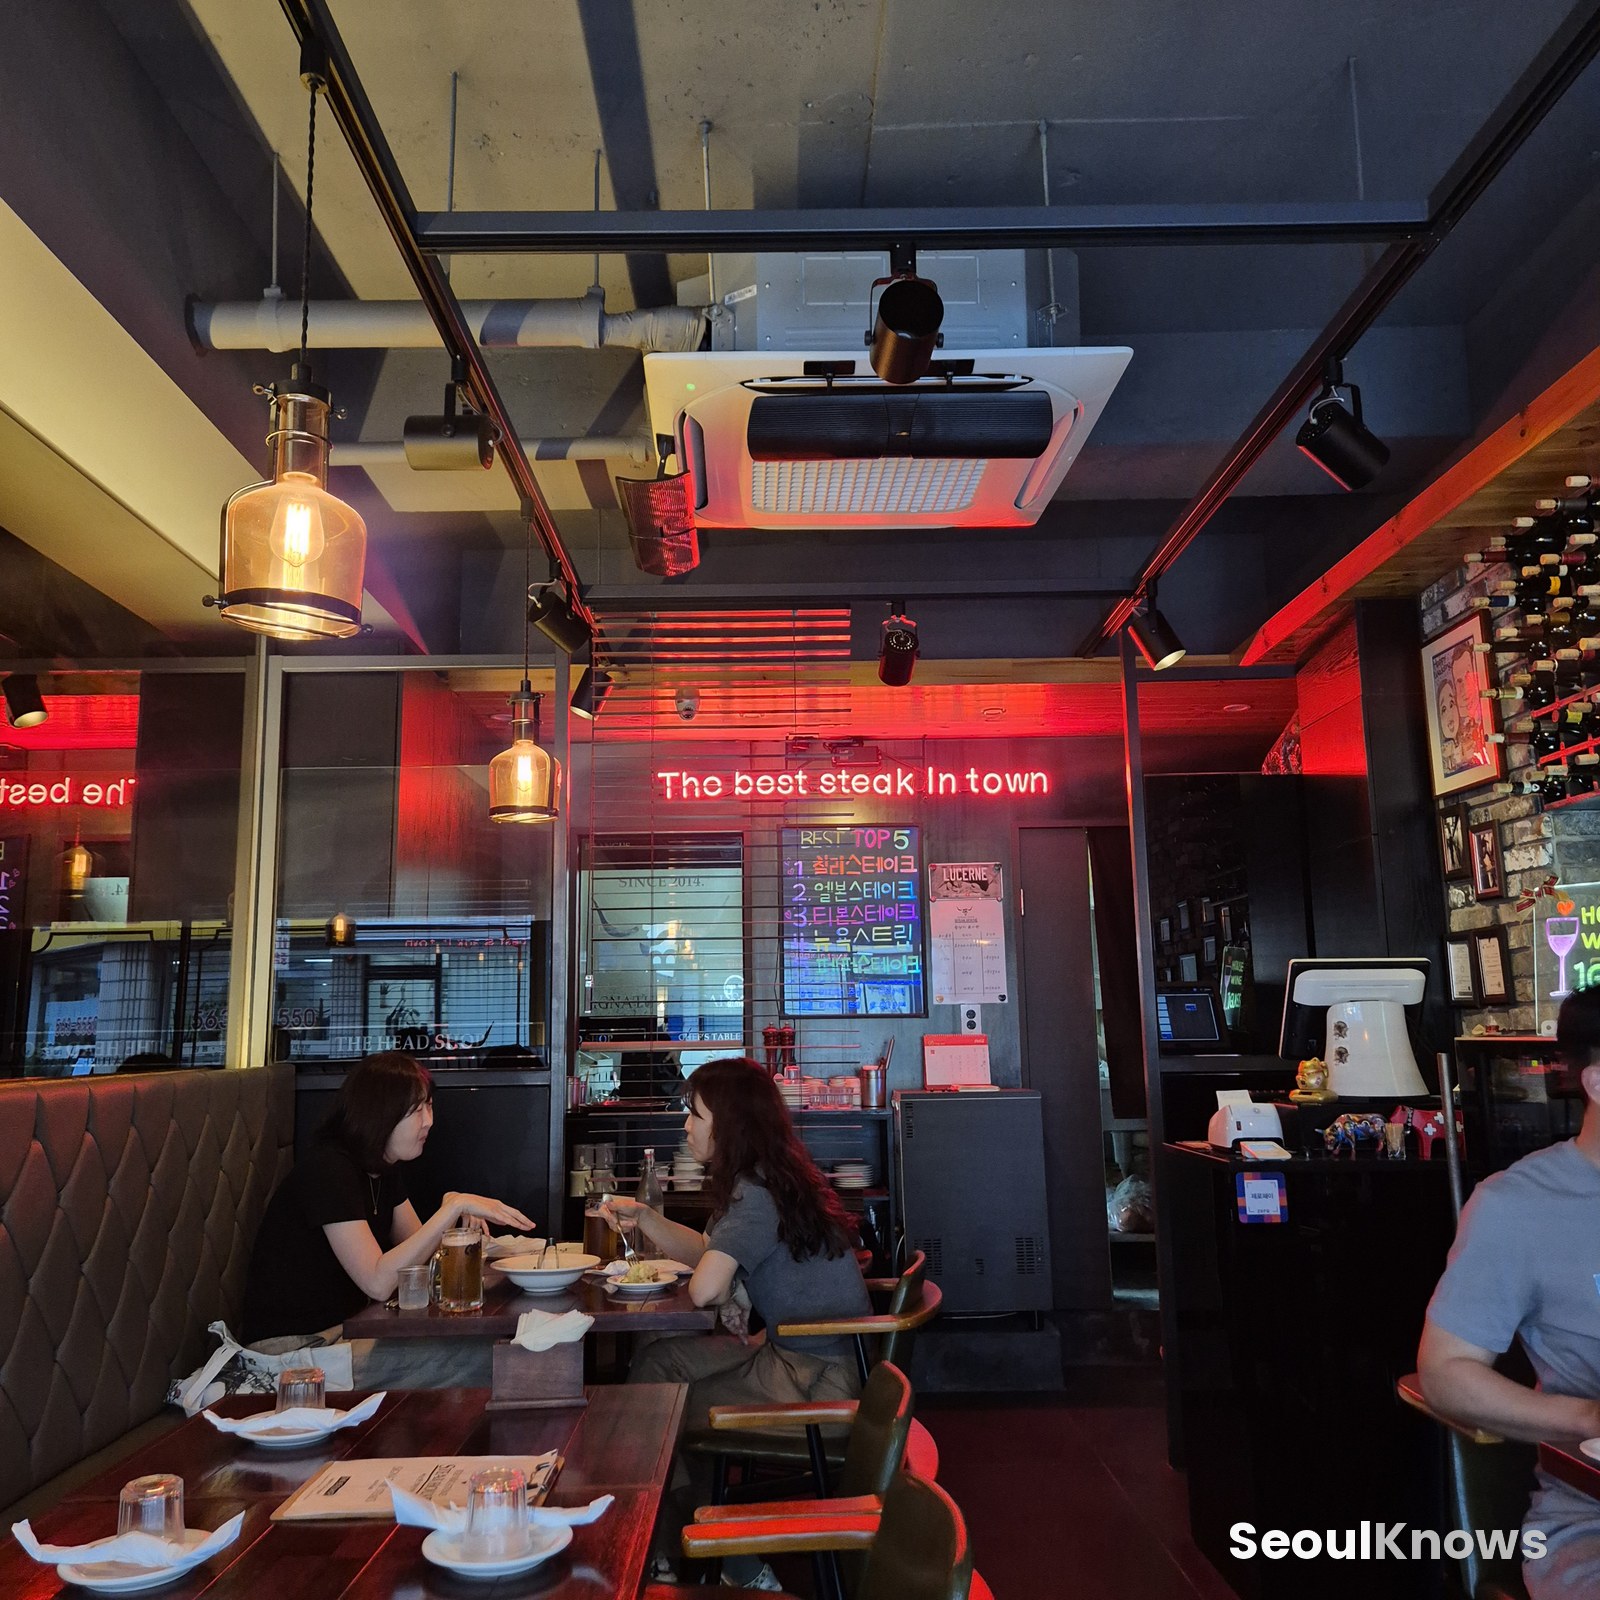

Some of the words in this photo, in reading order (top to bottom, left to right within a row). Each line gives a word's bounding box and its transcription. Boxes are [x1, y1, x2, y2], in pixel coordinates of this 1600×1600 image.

[657, 771, 722, 799] The
[734, 769, 807, 796] best
[819, 768, 914, 796] steak
[928, 766, 956, 795] In
[965, 767, 1048, 794] town
[800, 830, 845, 848] BEST
[851, 829, 890, 849] TOP
[893, 829, 910, 850] 5
[618, 877, 667, 888] SINCE
[943, 867, 988, 881] LUCERNE
[814, 881, 917, 903] 엘본스테이크
[814, 923, 912, 952] 뉴욕스트립
[376, 1034, 429, 1051] HEAD
[711, 1032, 741, 1041] TABLE
